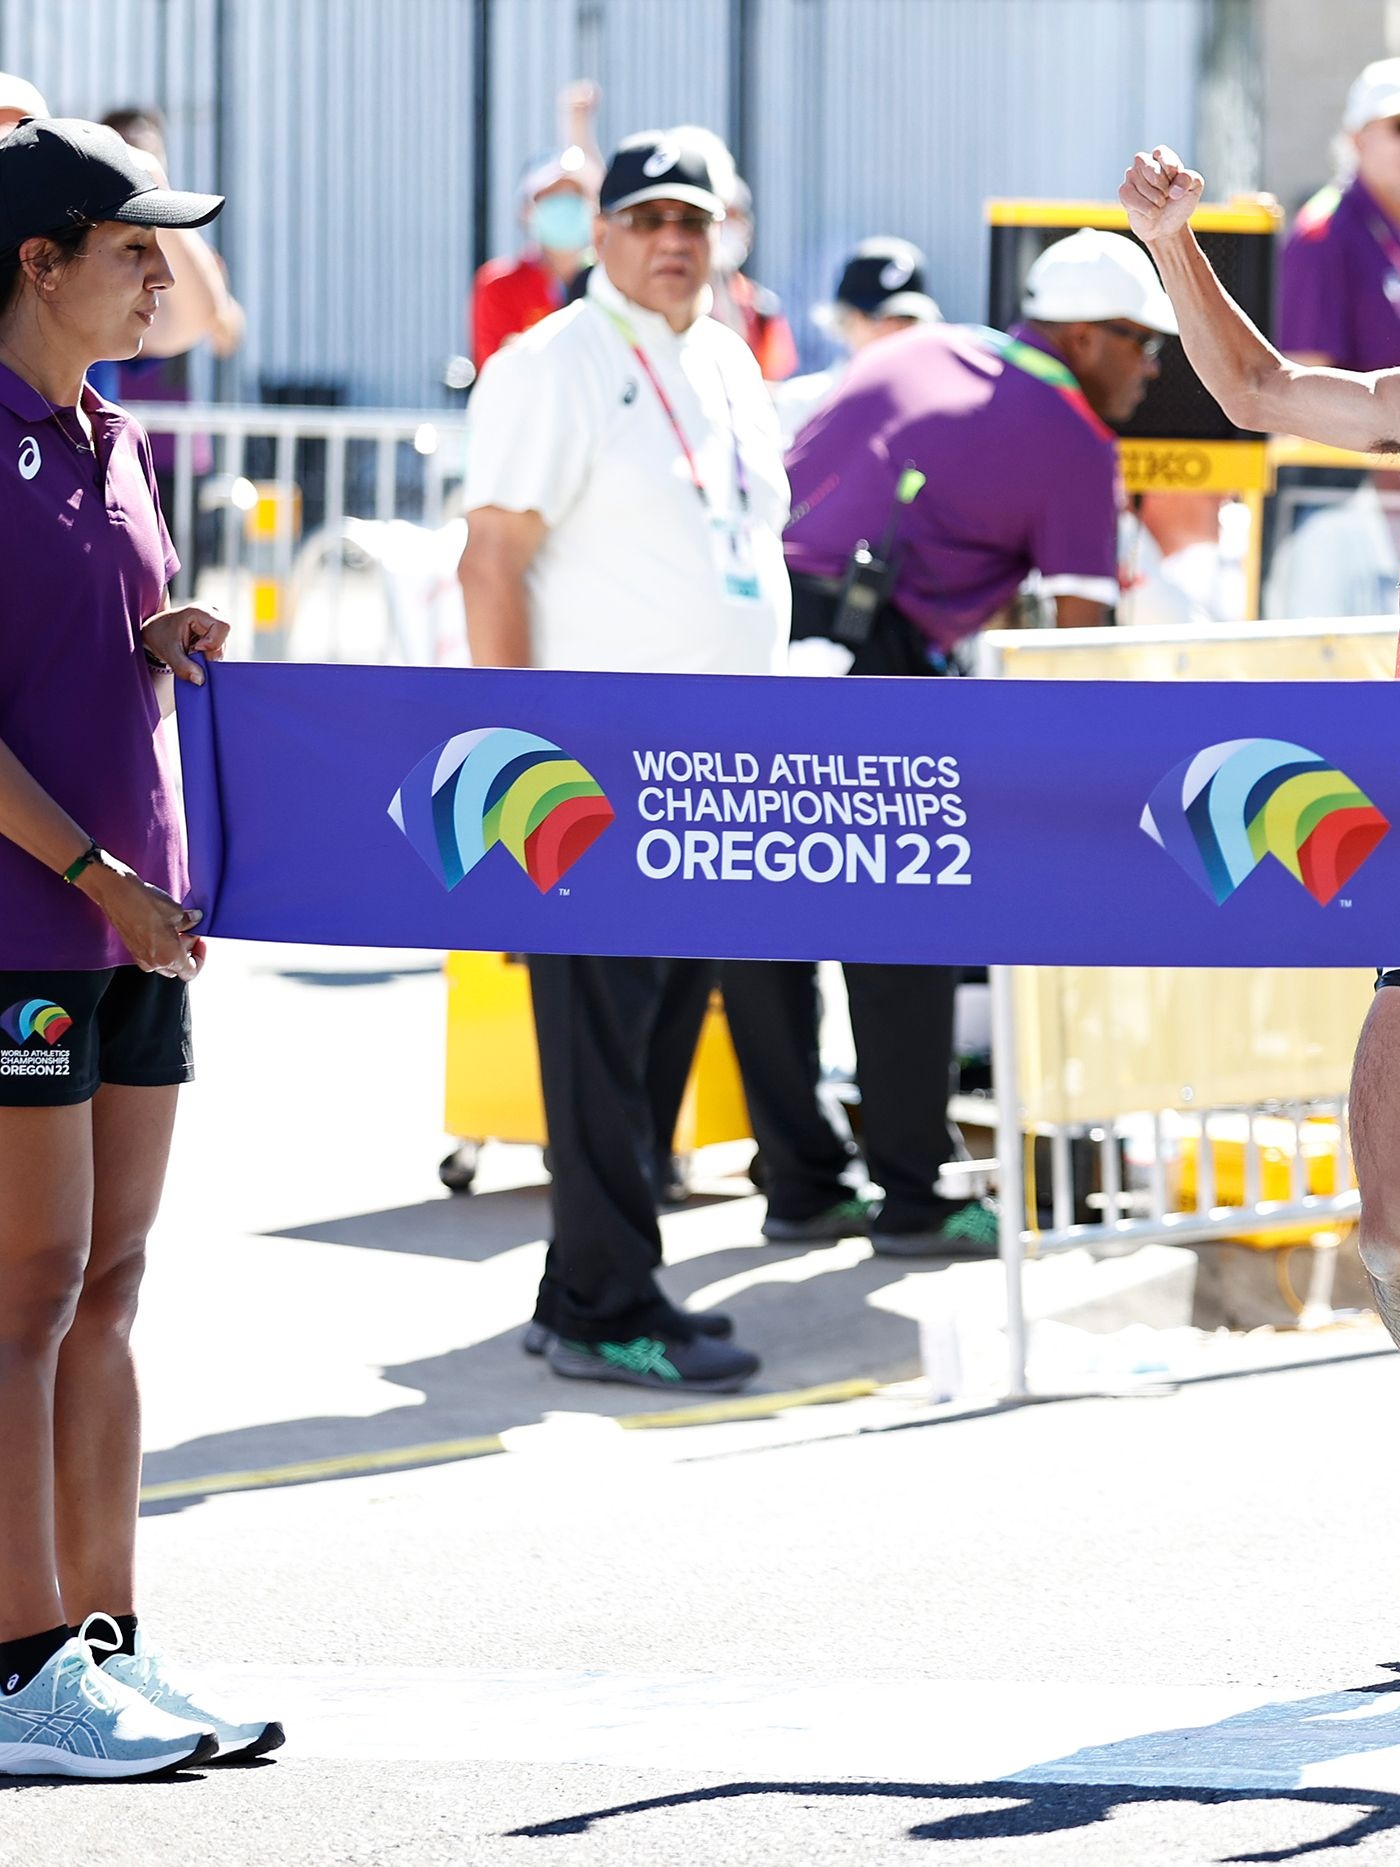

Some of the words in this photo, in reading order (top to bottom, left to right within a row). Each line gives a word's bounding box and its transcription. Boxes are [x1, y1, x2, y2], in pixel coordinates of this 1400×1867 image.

[633, 751, 759, 783] WORLD
[770, 754, 959, 788] ATHLETICS
[638, 787, 967, 827] CHAMPIONSHIPS
